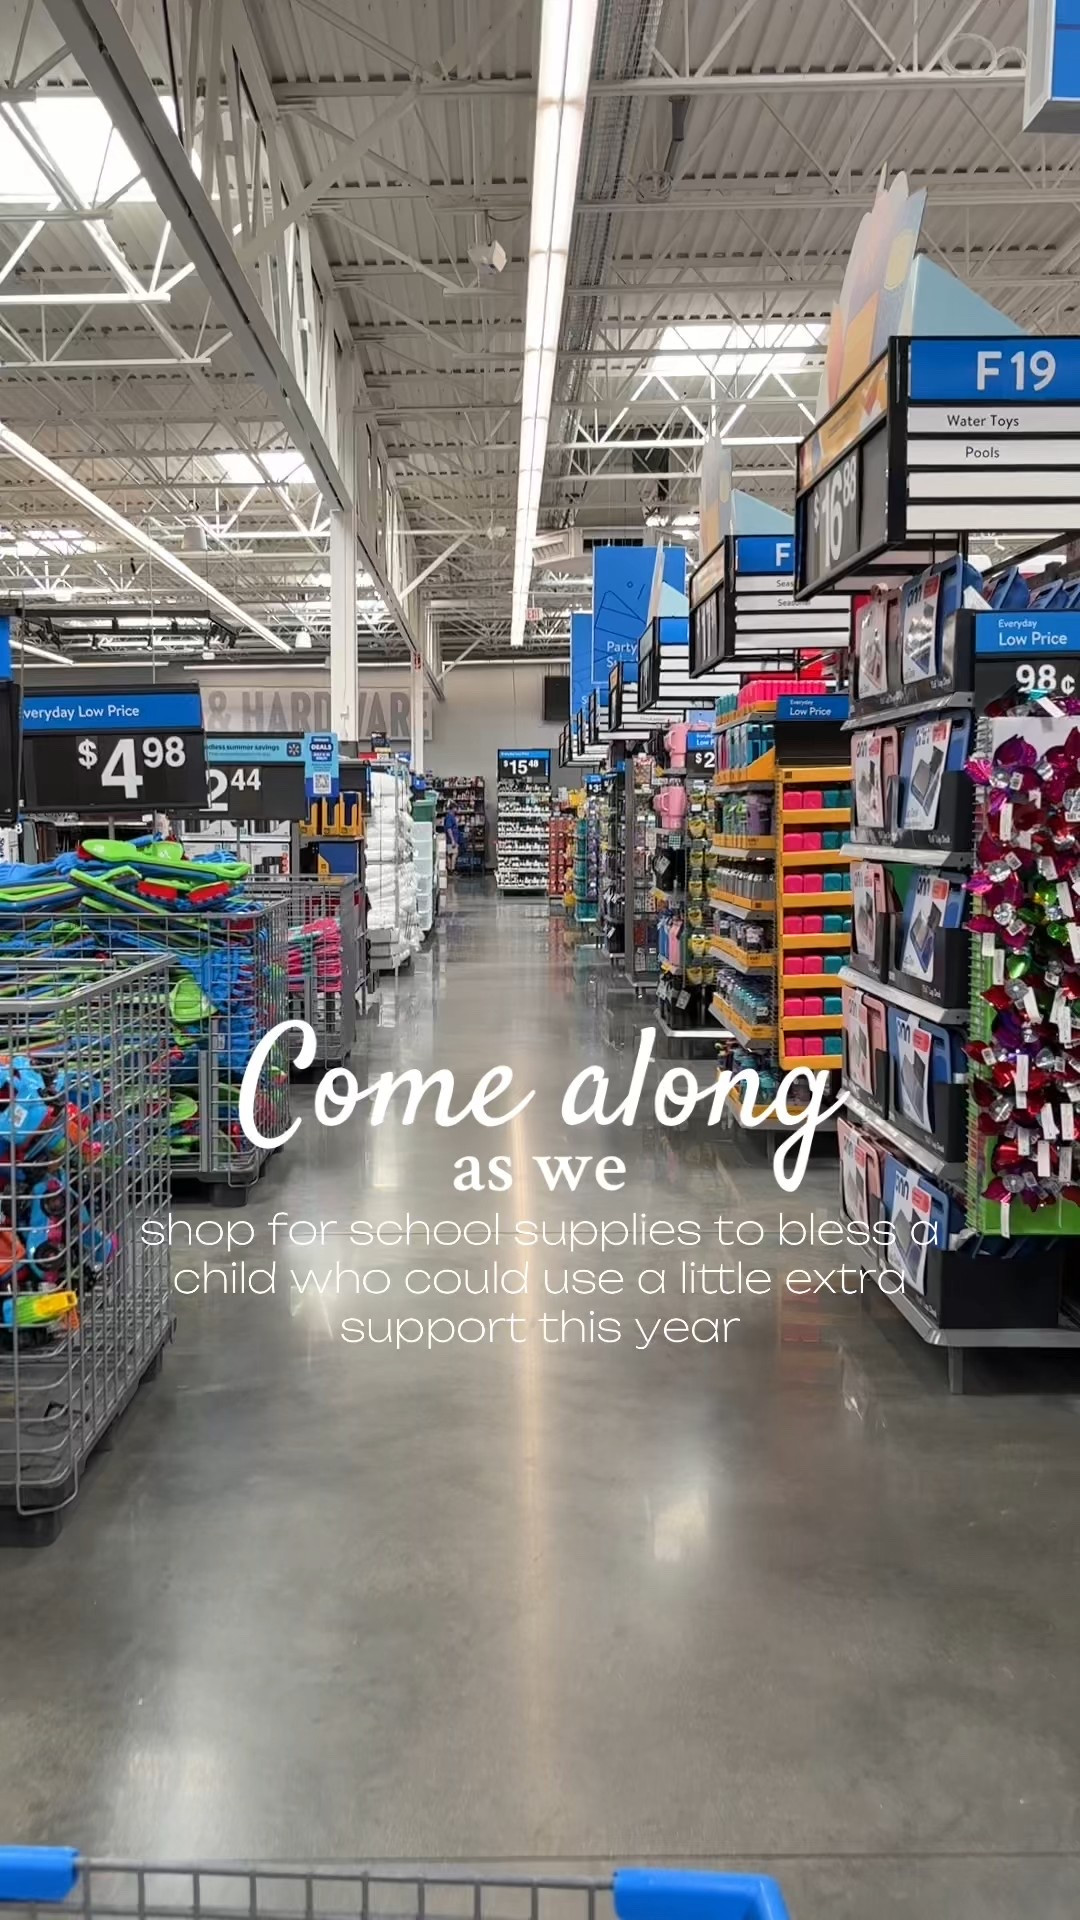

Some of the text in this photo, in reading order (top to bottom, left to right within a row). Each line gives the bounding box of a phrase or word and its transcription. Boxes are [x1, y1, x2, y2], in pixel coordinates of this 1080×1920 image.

[947, 414, 1019, 430] Water Toys
[965, 446, 1000, 458] Pools
[776, 579, 795, 588] Seas
[998, 619, 1037, 630] Everyday
[999, 632, 1068, 646] Low Price
[607, 640, 637, 655] Party
[78, 704, 104, 718] Low
[107, 703, 140, 717] Price
[242, 691, 429, 738] HARDAR
[789, 707, 832, 717] Low Price
[255, 744, 280, 752] savings
